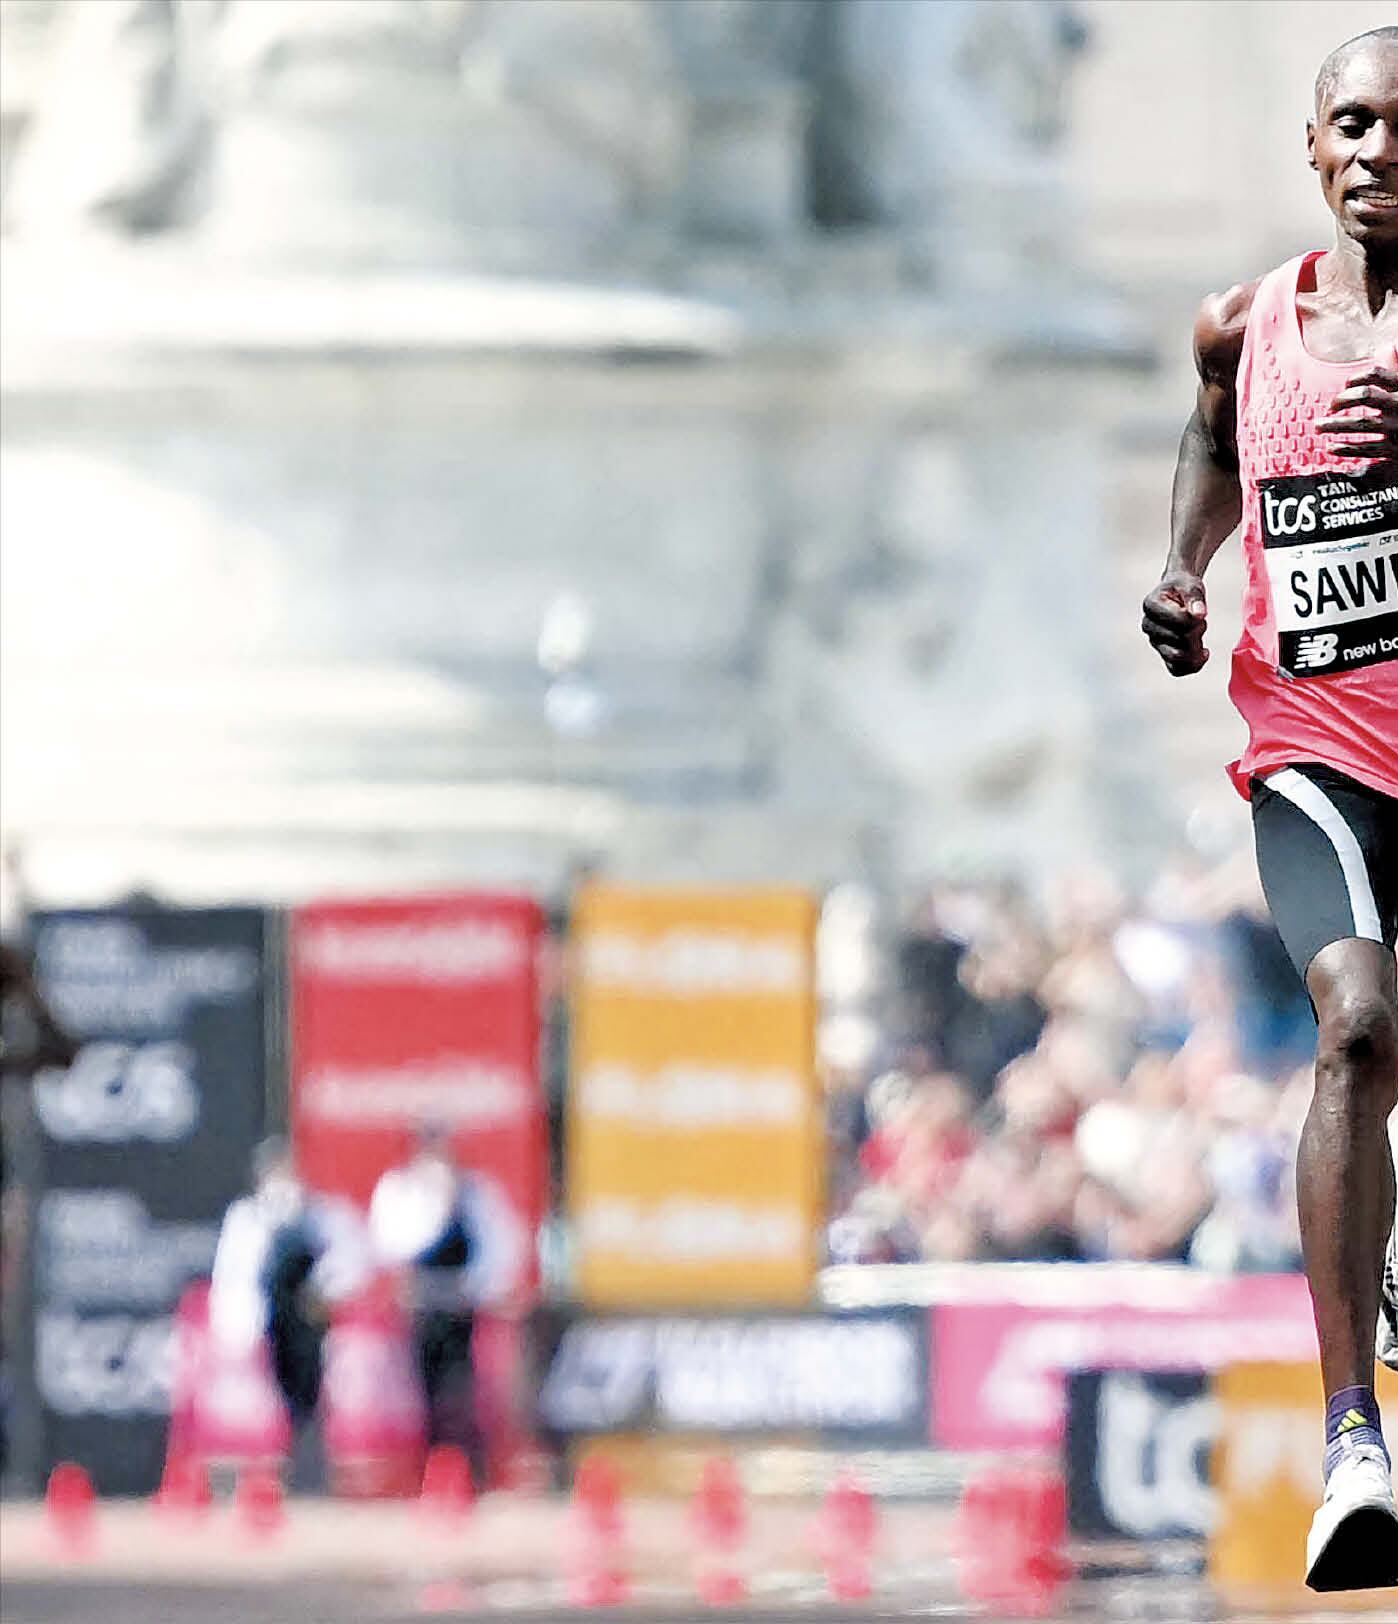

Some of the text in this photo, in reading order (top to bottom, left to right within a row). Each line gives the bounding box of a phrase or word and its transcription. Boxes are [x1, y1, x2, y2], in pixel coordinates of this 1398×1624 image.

[1264, 485, 1317, 535] tcs
[1322, 506, 1385, 530] SERVICES
[1343, 640, 1377, 661] new
